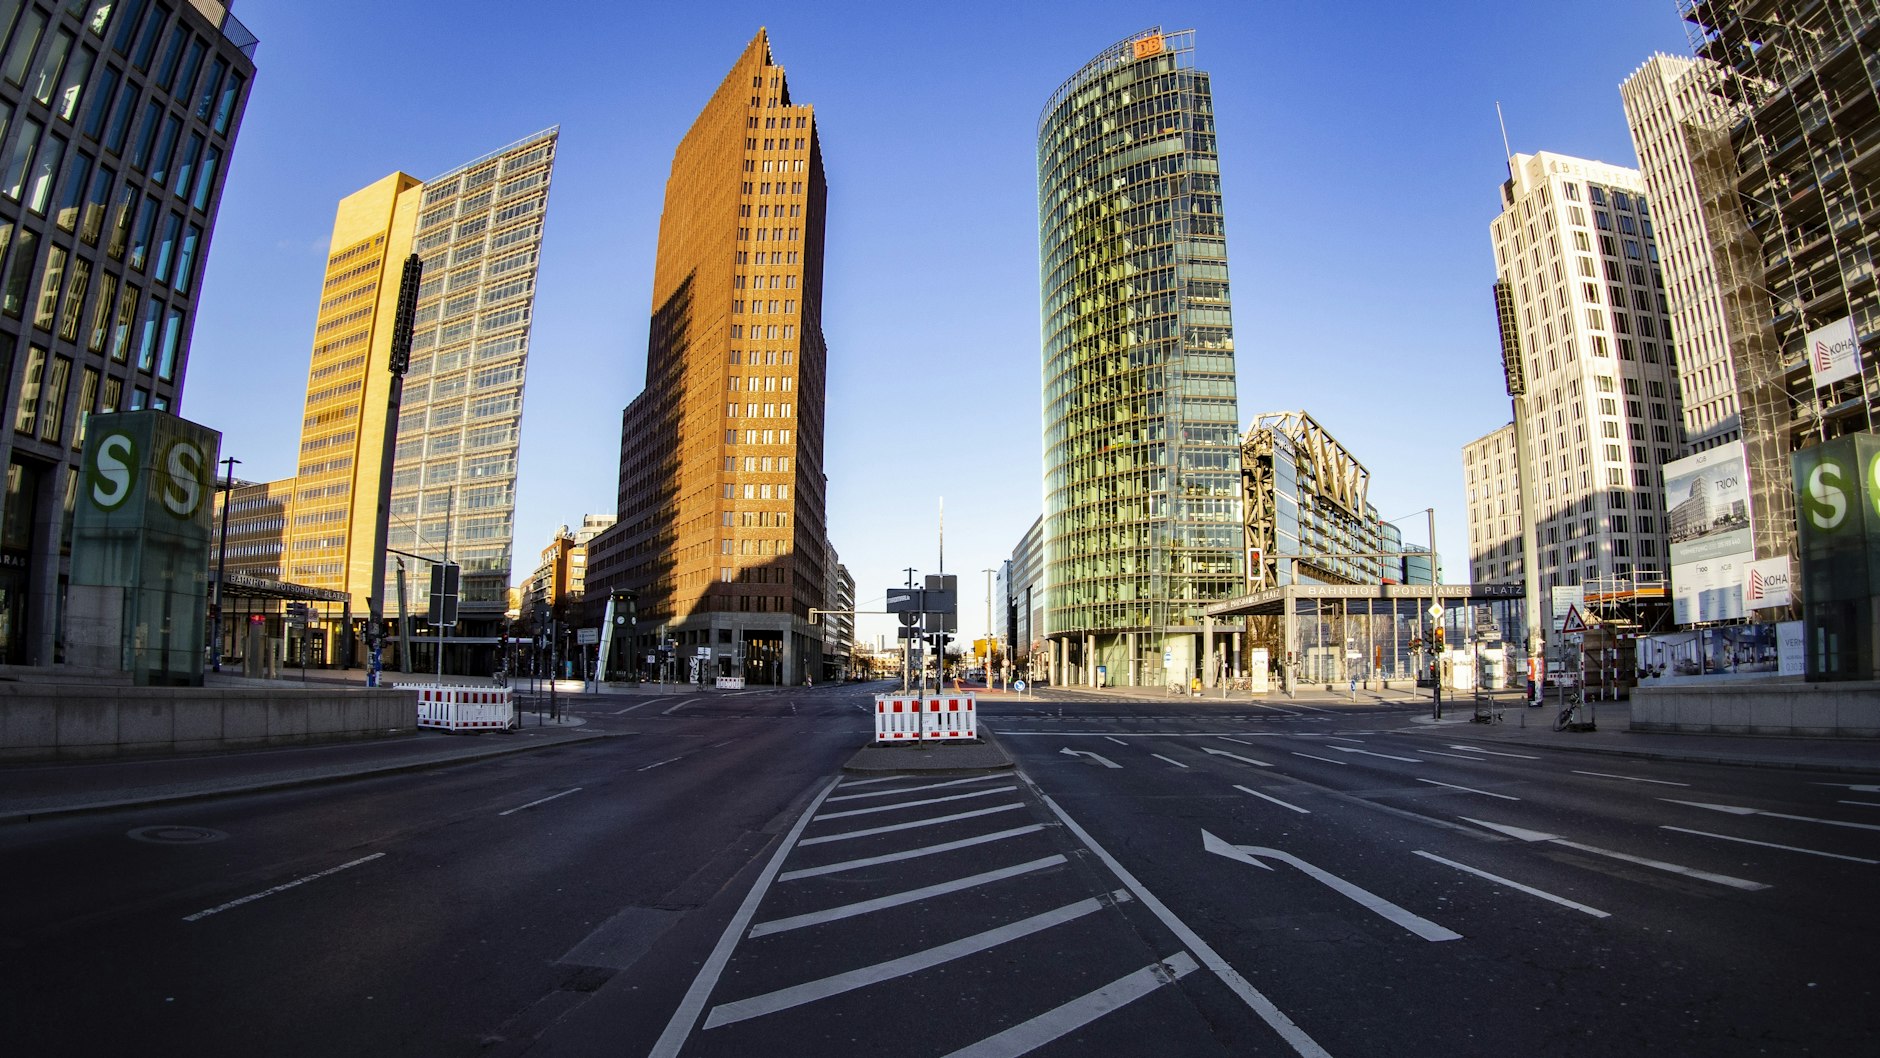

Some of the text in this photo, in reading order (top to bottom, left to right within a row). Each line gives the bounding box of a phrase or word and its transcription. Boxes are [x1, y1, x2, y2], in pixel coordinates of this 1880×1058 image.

[1137, 38, 1160, 54] DB
[1829, 338, 1855, 356] KOHA
[94, 434, 131, 507] S
[164, 442, 201, 515] S
[1715, 476, 1738, 491] TRION
[1809, 463, 1847, 529] S
[229, 574, 345, 600] BAHNHOF POTSDAMER PLATZ
[1764, 573, 1788, 587] KOHA
[1308, 586, 1378, 595] BAHNHOF
[1484, 585, 1523, 595] PLATZ
